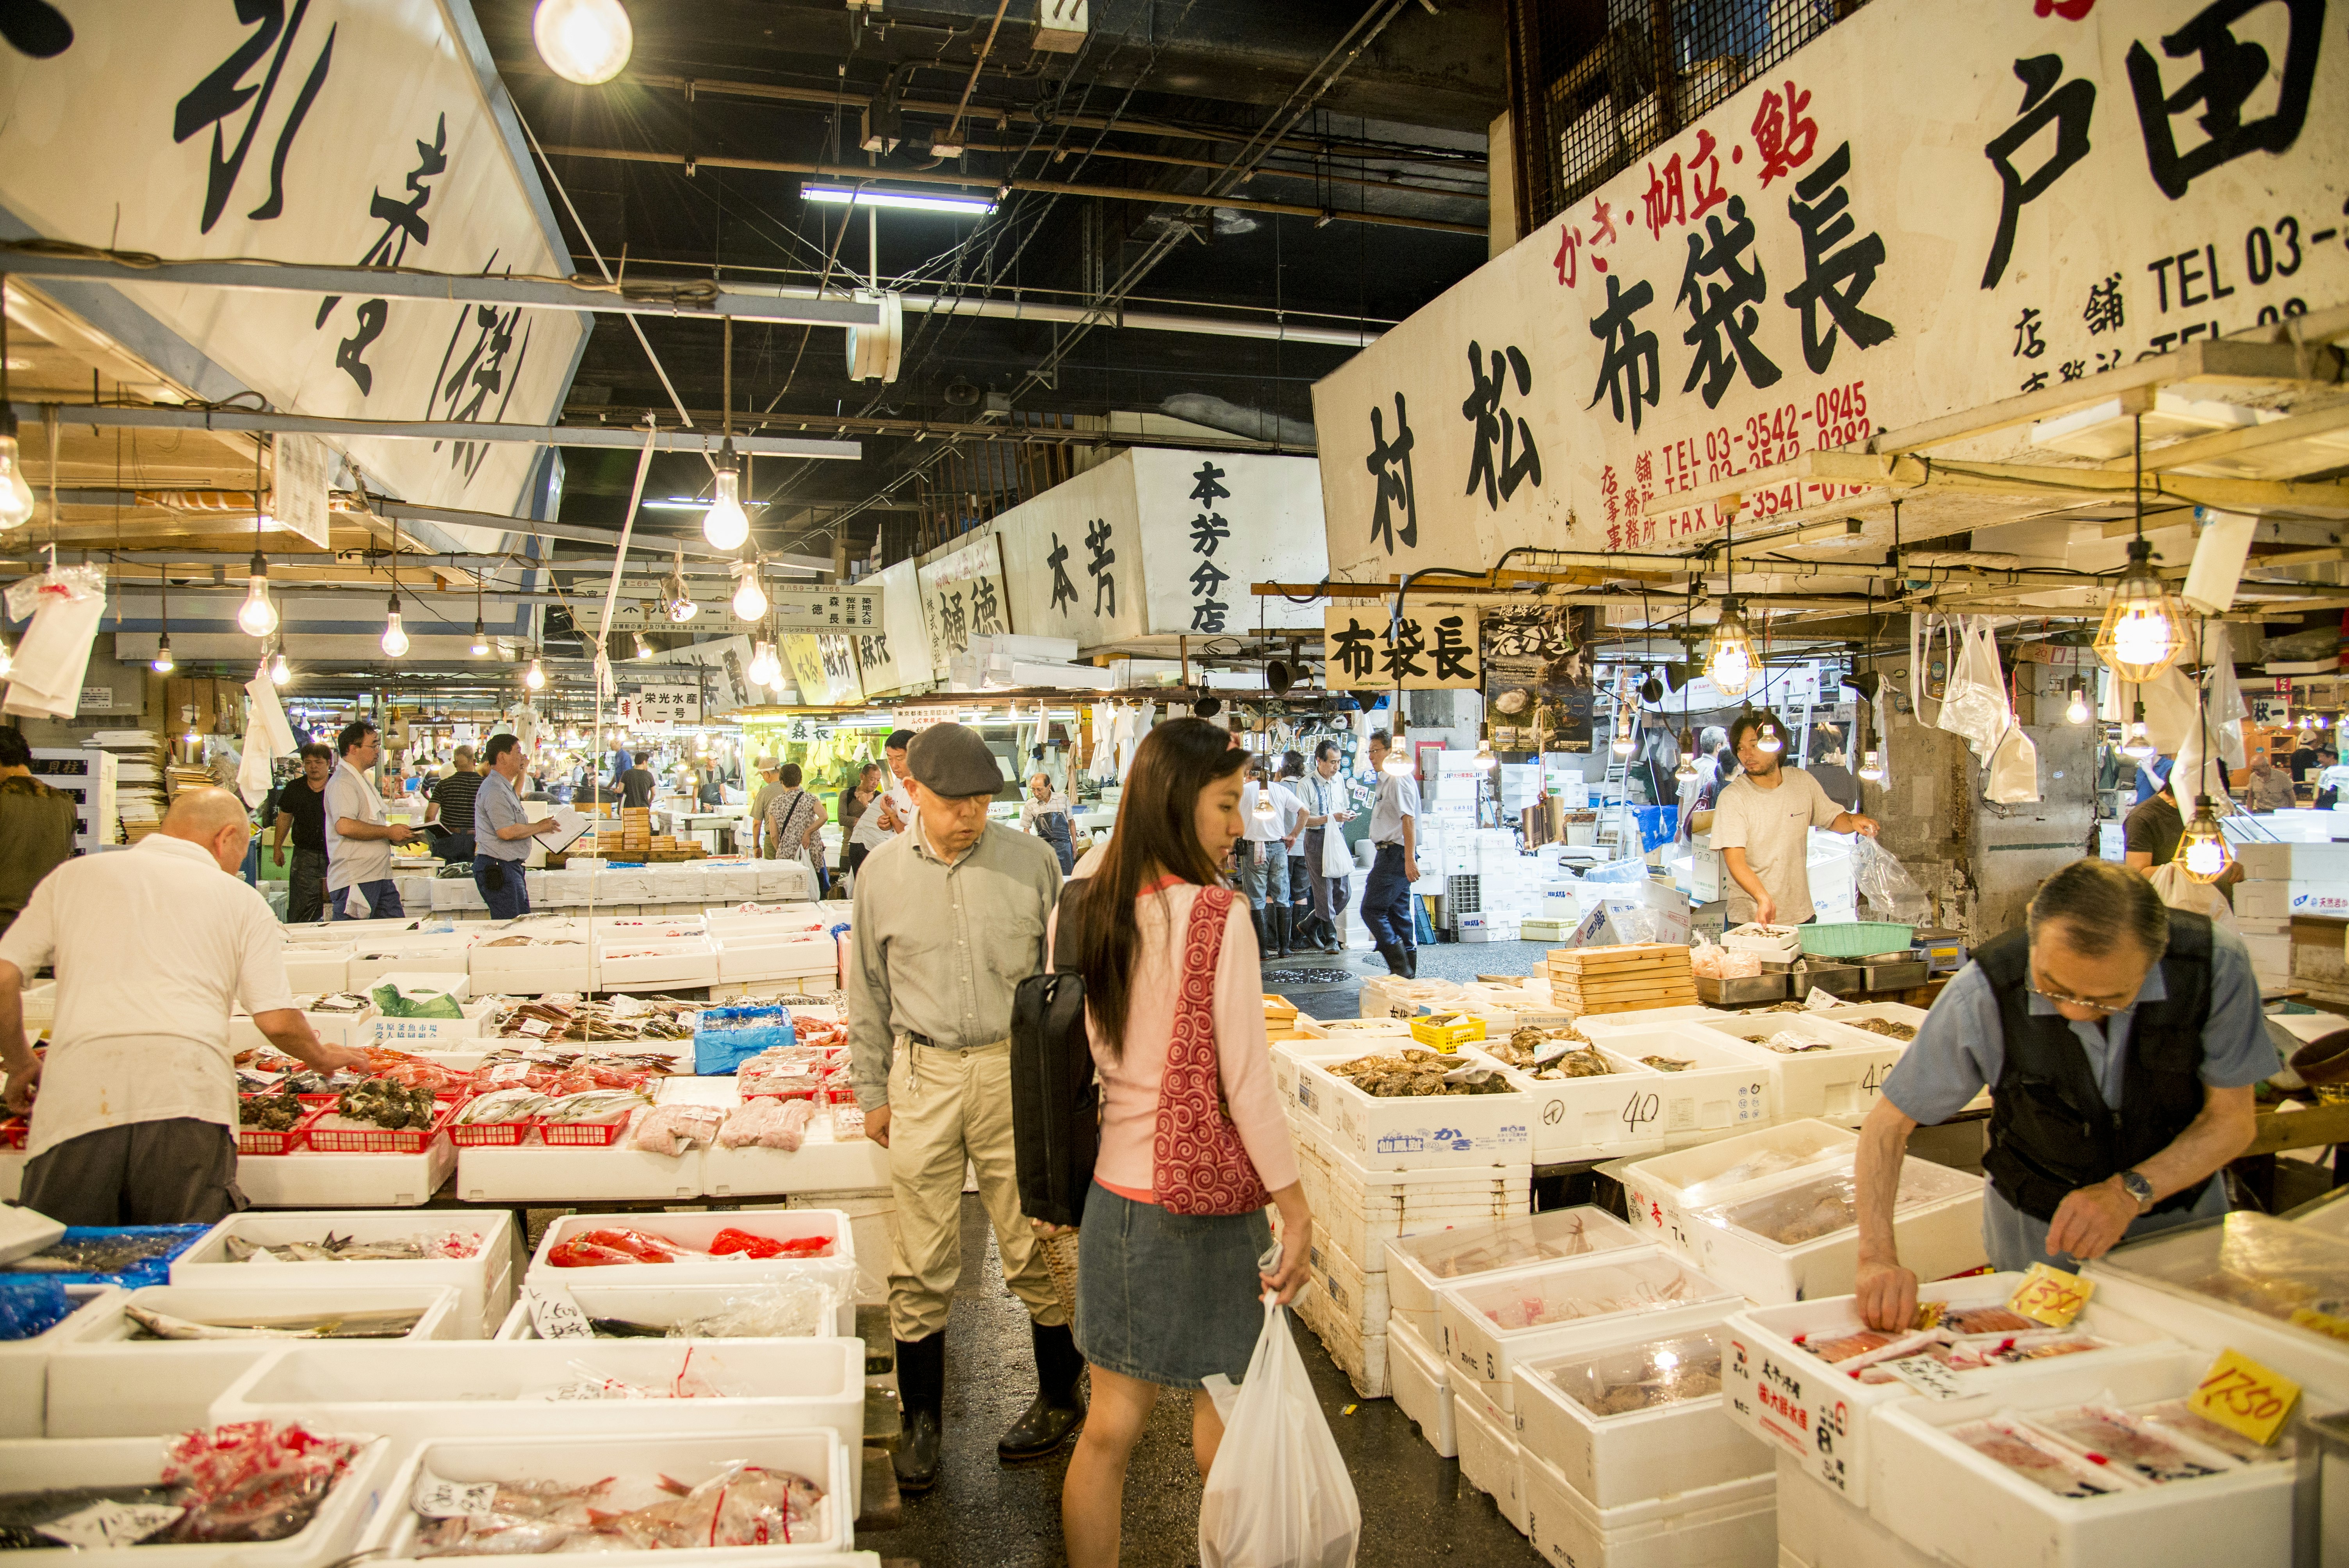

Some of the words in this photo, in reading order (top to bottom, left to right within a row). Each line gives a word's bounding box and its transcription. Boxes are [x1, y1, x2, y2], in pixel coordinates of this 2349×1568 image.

[2148, 244, 2234, 313] TEL
[2246, 200, 2349, 285] 03-
[1585, 140, 1896, 434] 布袋長
[1367, 340, 1542, 555] 村松
[1663, 438, 1700, 475] TEL
[1707, 381, 1866, 462] 03-3542-0945
[1047, 518, 1116, 620] 本芳
[1189, 461, 1230, 634] 本芳分店
[829, 596, 839, 624] 森長
[846, 597, 856, 624] 桜井三善
[862, 597, 872, 624] 築地大谷
[927, 598, 941, 663] 株式会社
[1329, 616, 1477, 682] 布袋長
[645, 693, 697, 704] 栄光水産
[657, 708, 685, 718] 一号
[1623, 1091, 1659, 1132] 40
[1356, 1133, 1366, 1151] 50
[1816, 1424, 1833, 1455] 8
